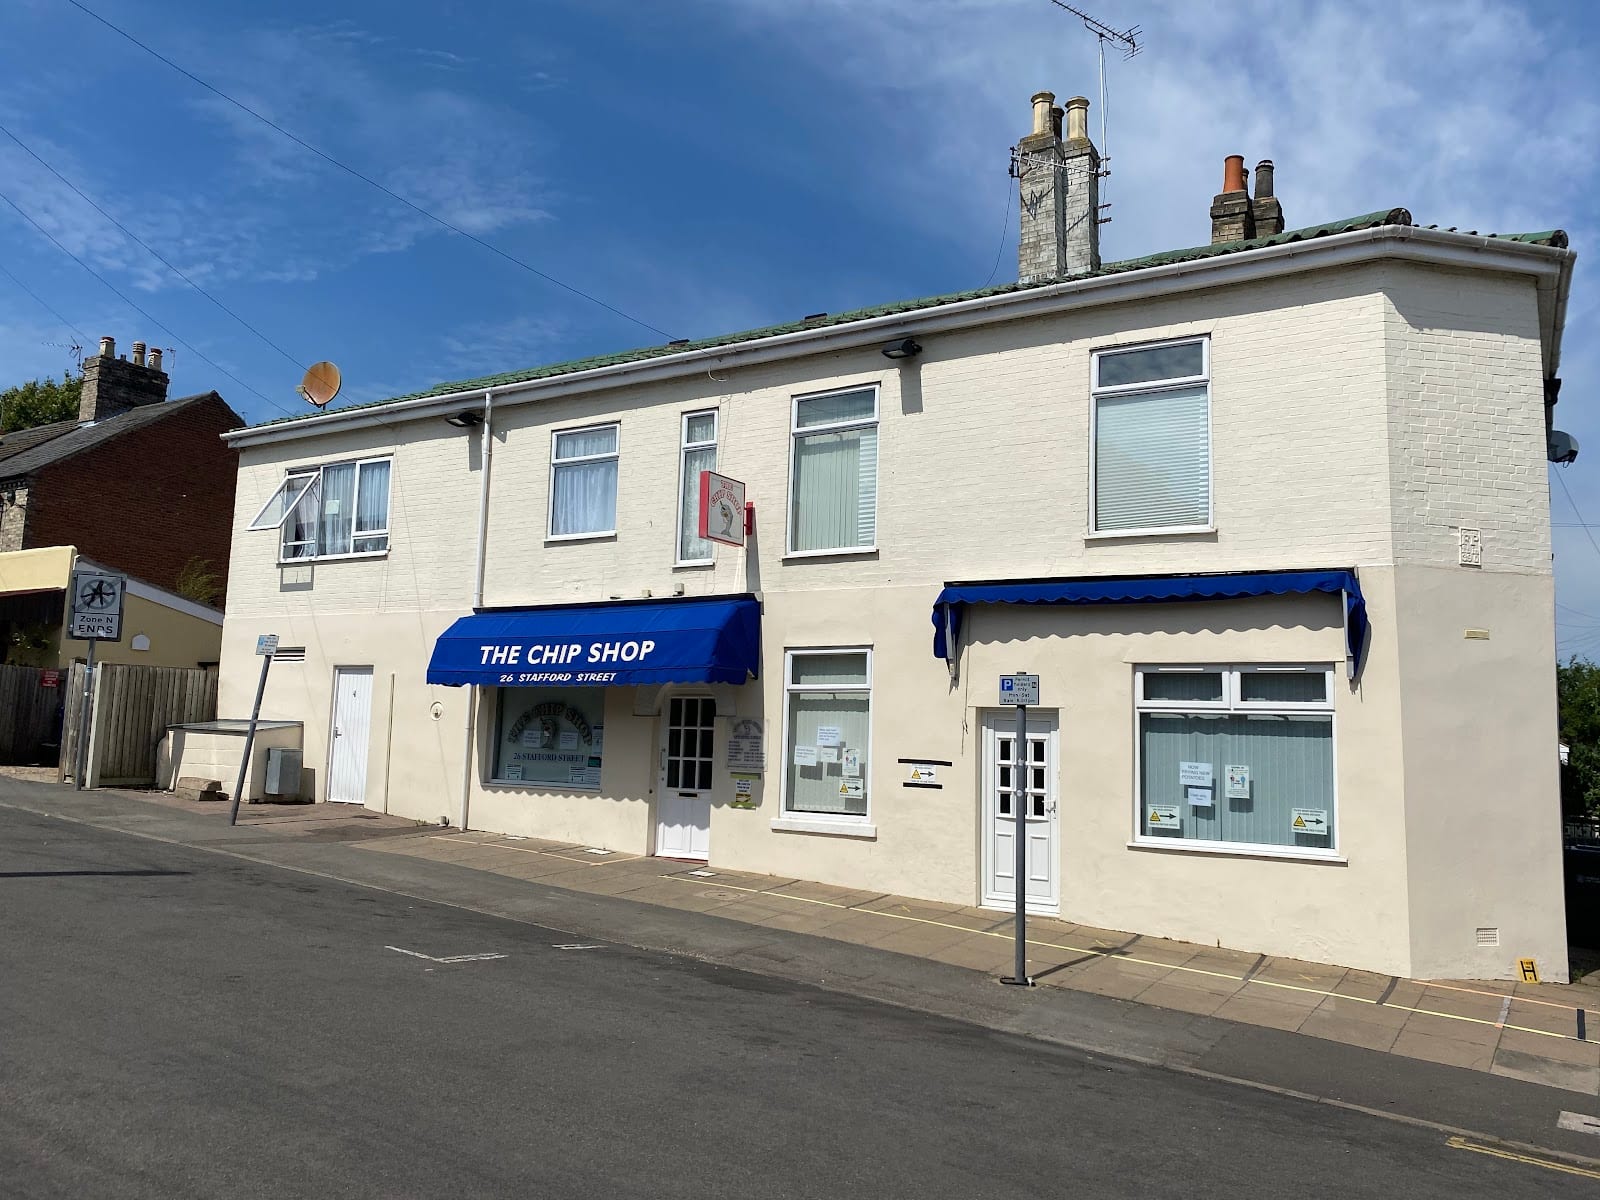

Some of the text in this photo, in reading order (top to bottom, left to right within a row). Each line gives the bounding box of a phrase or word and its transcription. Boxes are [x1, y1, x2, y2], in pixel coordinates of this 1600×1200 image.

[710, 488, 743, 516] CHIP SHOP
[78, 624, 113, 634] ENDS
[480, 640, 656, 665] THE CHIP SHOP
[500, 672, 617, 682] 26 STAFFORD STREET
[1004, 679, 1012, 690] P
[521, 753, 557, 761] STAFFORD
[558, 754, 584, 762] STREET
[1520, 960, 1537, 981] H
